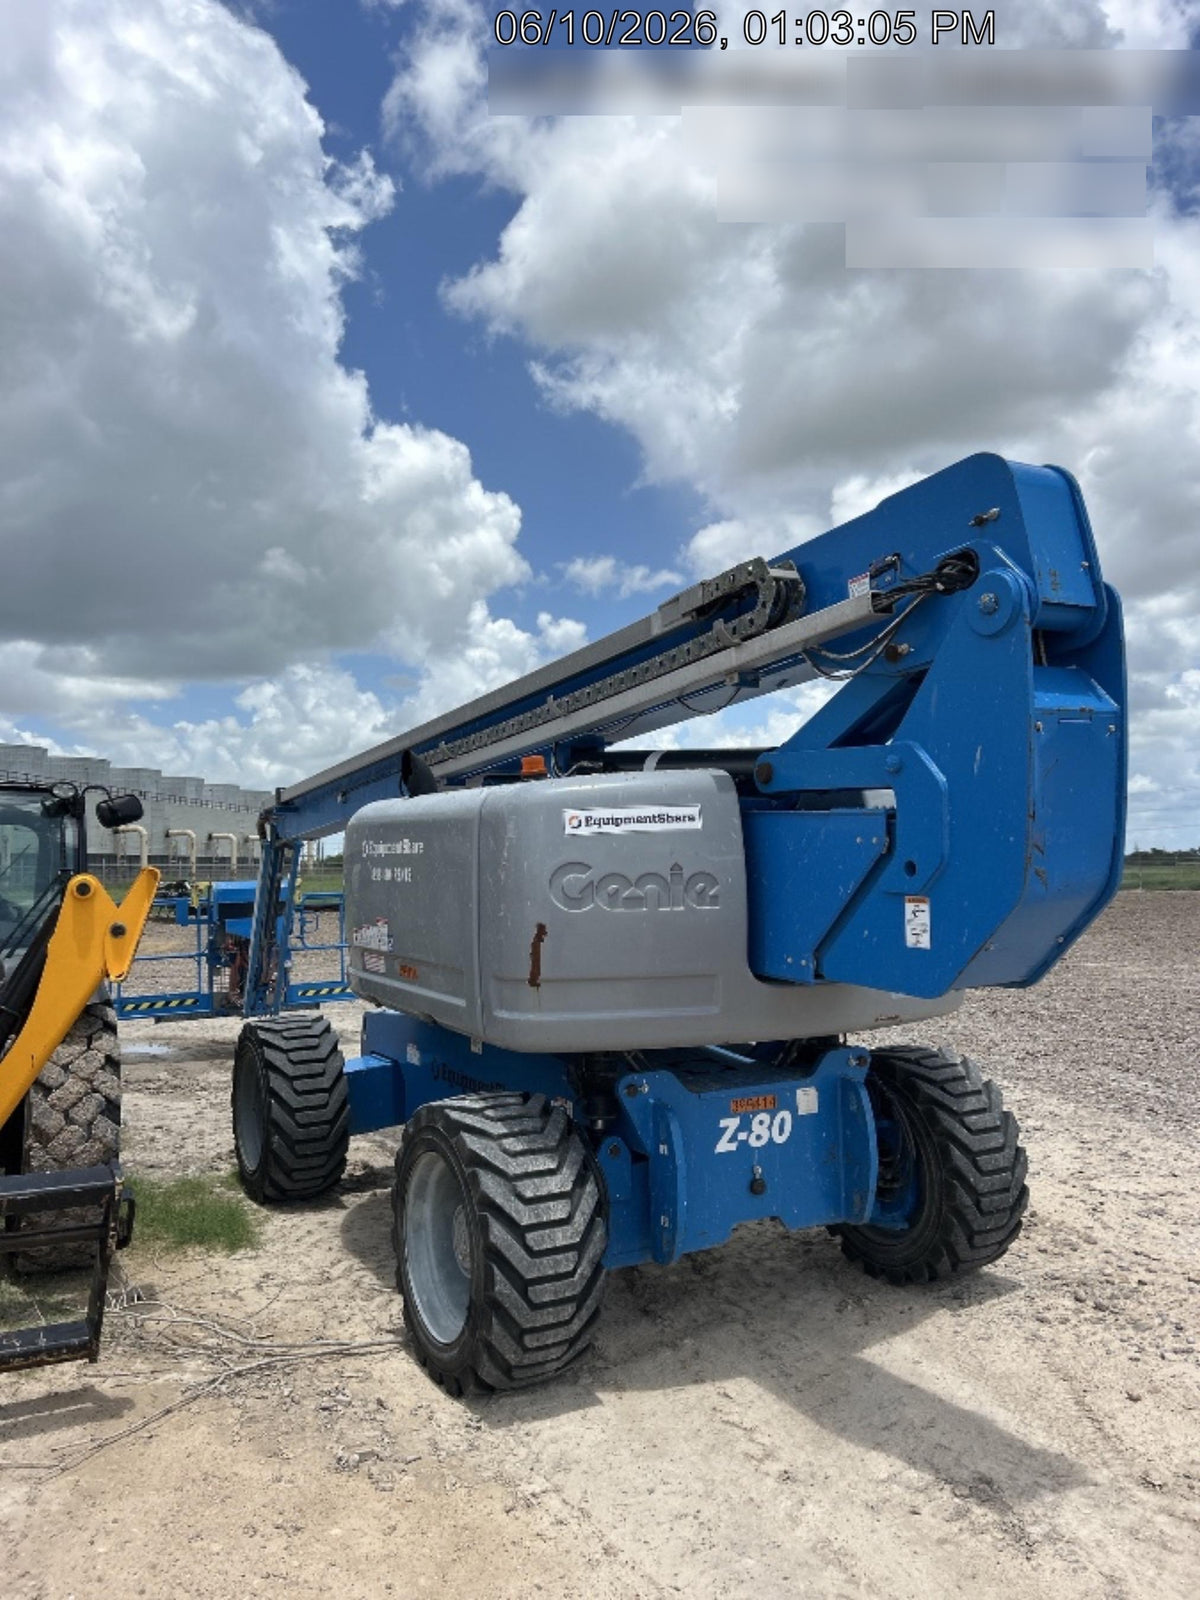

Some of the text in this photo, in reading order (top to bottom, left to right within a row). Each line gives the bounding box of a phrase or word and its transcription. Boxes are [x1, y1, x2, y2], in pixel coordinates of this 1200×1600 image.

[584, 813, 696, 828] EquipmentShare
[549, 861, 721, 913] Genie
[714, 1110, 792, 1154] Z-80
